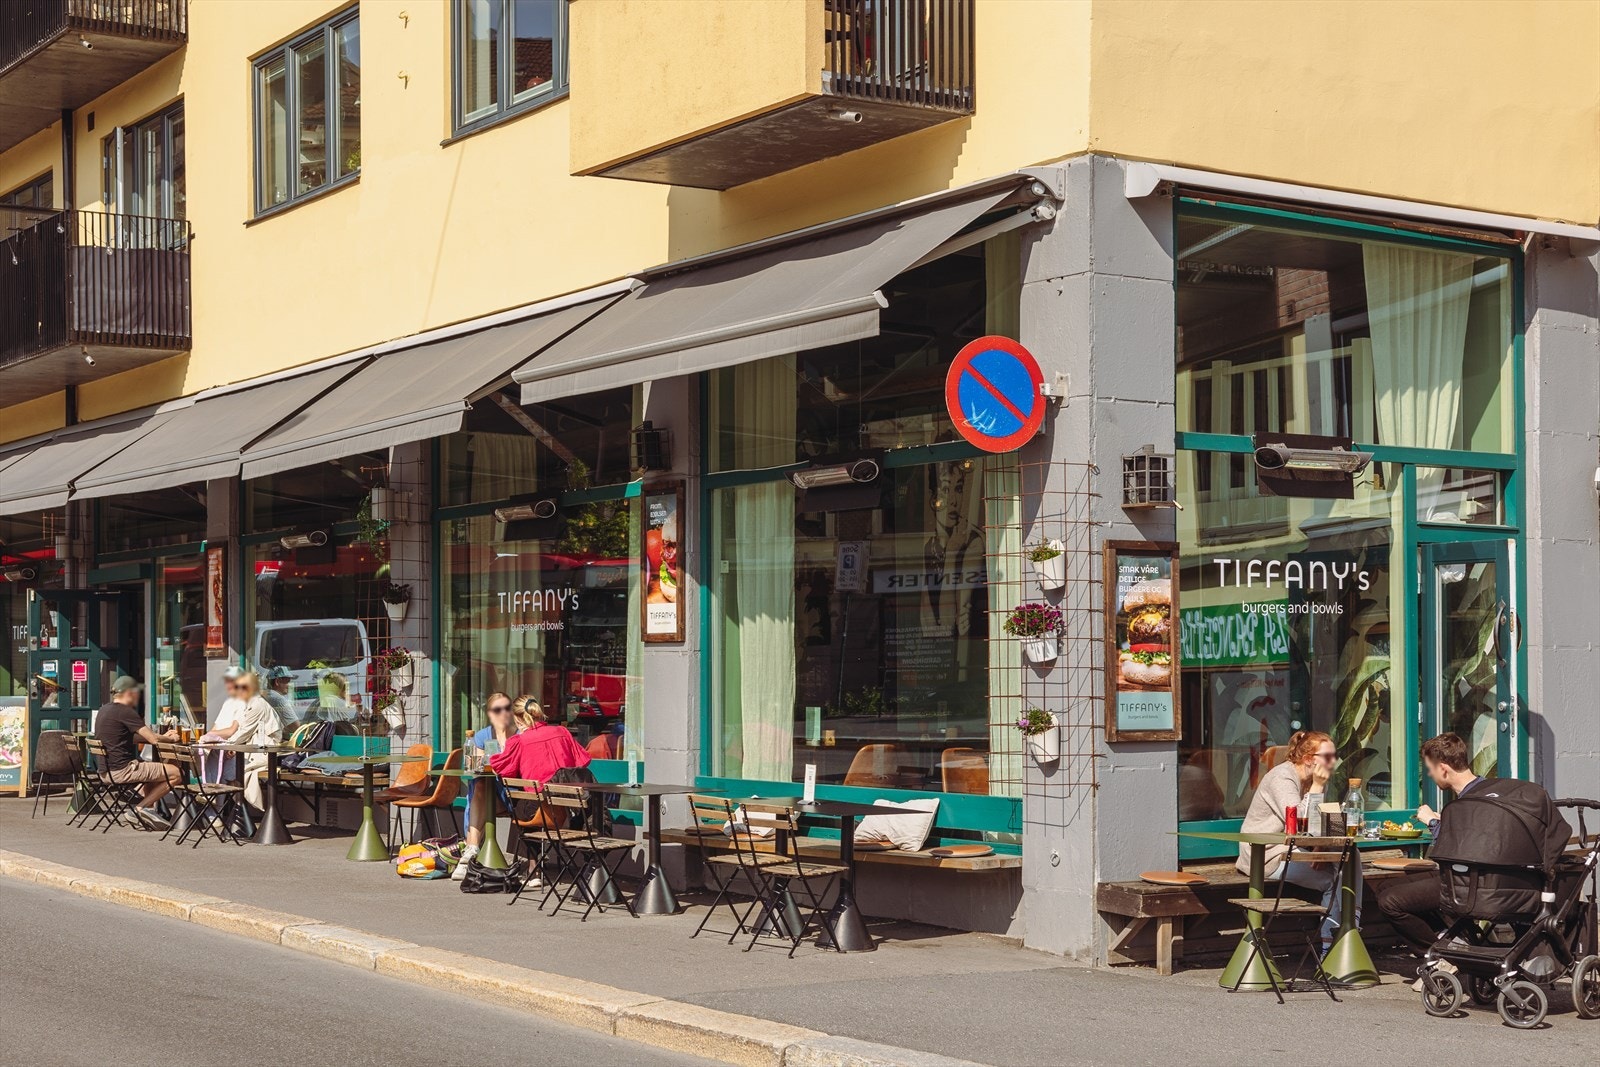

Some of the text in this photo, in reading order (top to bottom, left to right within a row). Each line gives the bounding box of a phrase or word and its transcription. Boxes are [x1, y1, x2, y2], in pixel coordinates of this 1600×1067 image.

[1119, 564, 1159, 574] SMAK VÅRE
[1213, 559, 1370, 591] TIFFANY's
[497, 588, 579, 613] TIFFANY's
[1242, 600, 1344, 616] burgers and bowls
[511, 620, 564, 633] burgers and bowls
[1120, 702, 1167, 712] TIFFANY's
